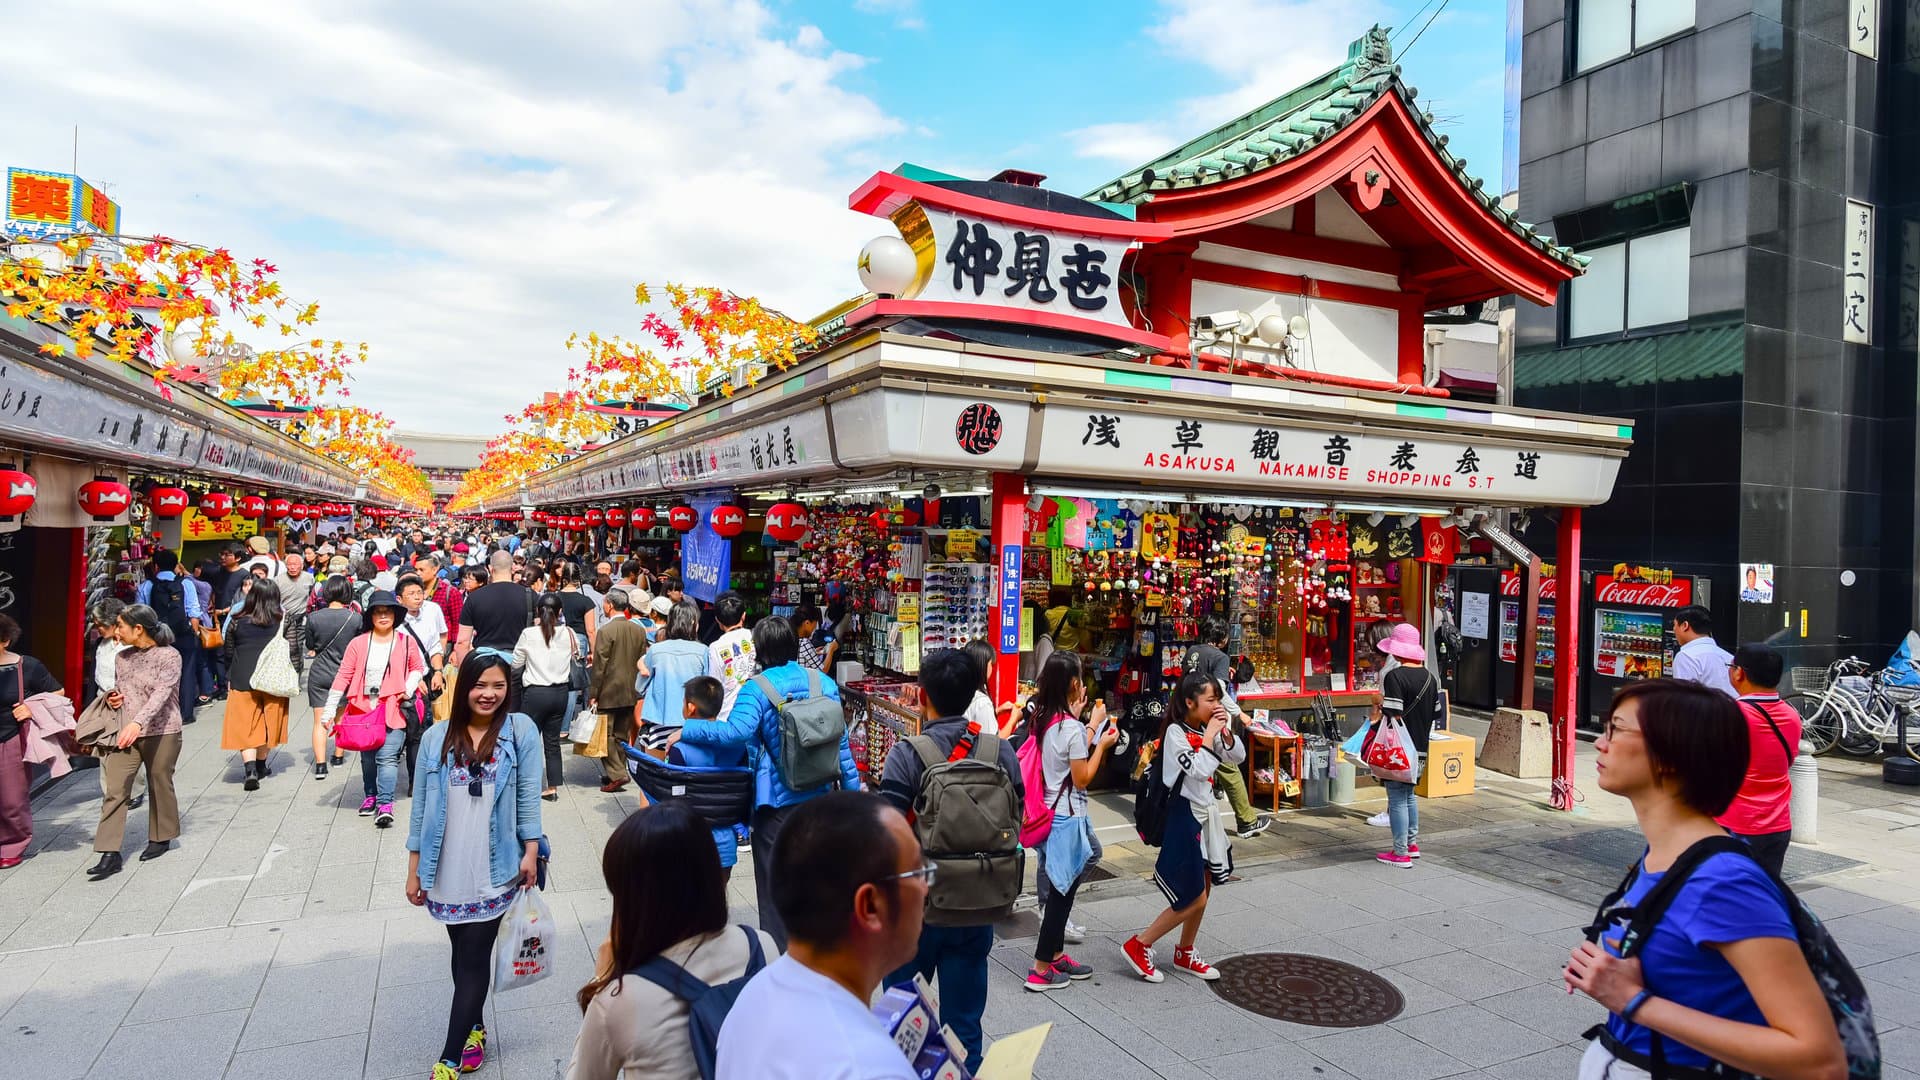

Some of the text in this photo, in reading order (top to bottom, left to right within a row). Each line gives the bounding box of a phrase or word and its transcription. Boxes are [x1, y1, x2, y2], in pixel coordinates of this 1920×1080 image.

[11, 176, 69, 220] 薬
[945, 219, 1112, 310] 仲見世
[750, 425, 798, 471] 福光屋
[1082, 415, 1540, 480] 浅草観音表参道
[1144, 452, 1496, 490] ASAKUSA NAKAMISE SHOPPING S.T
[188, 519, 233, 536] 半額
[1005, 569, 1017, 627] 浅草一丁目
[1598, 582, 1684, 608] Coca-Cola
[1004, 635, 1016, 647] 18
